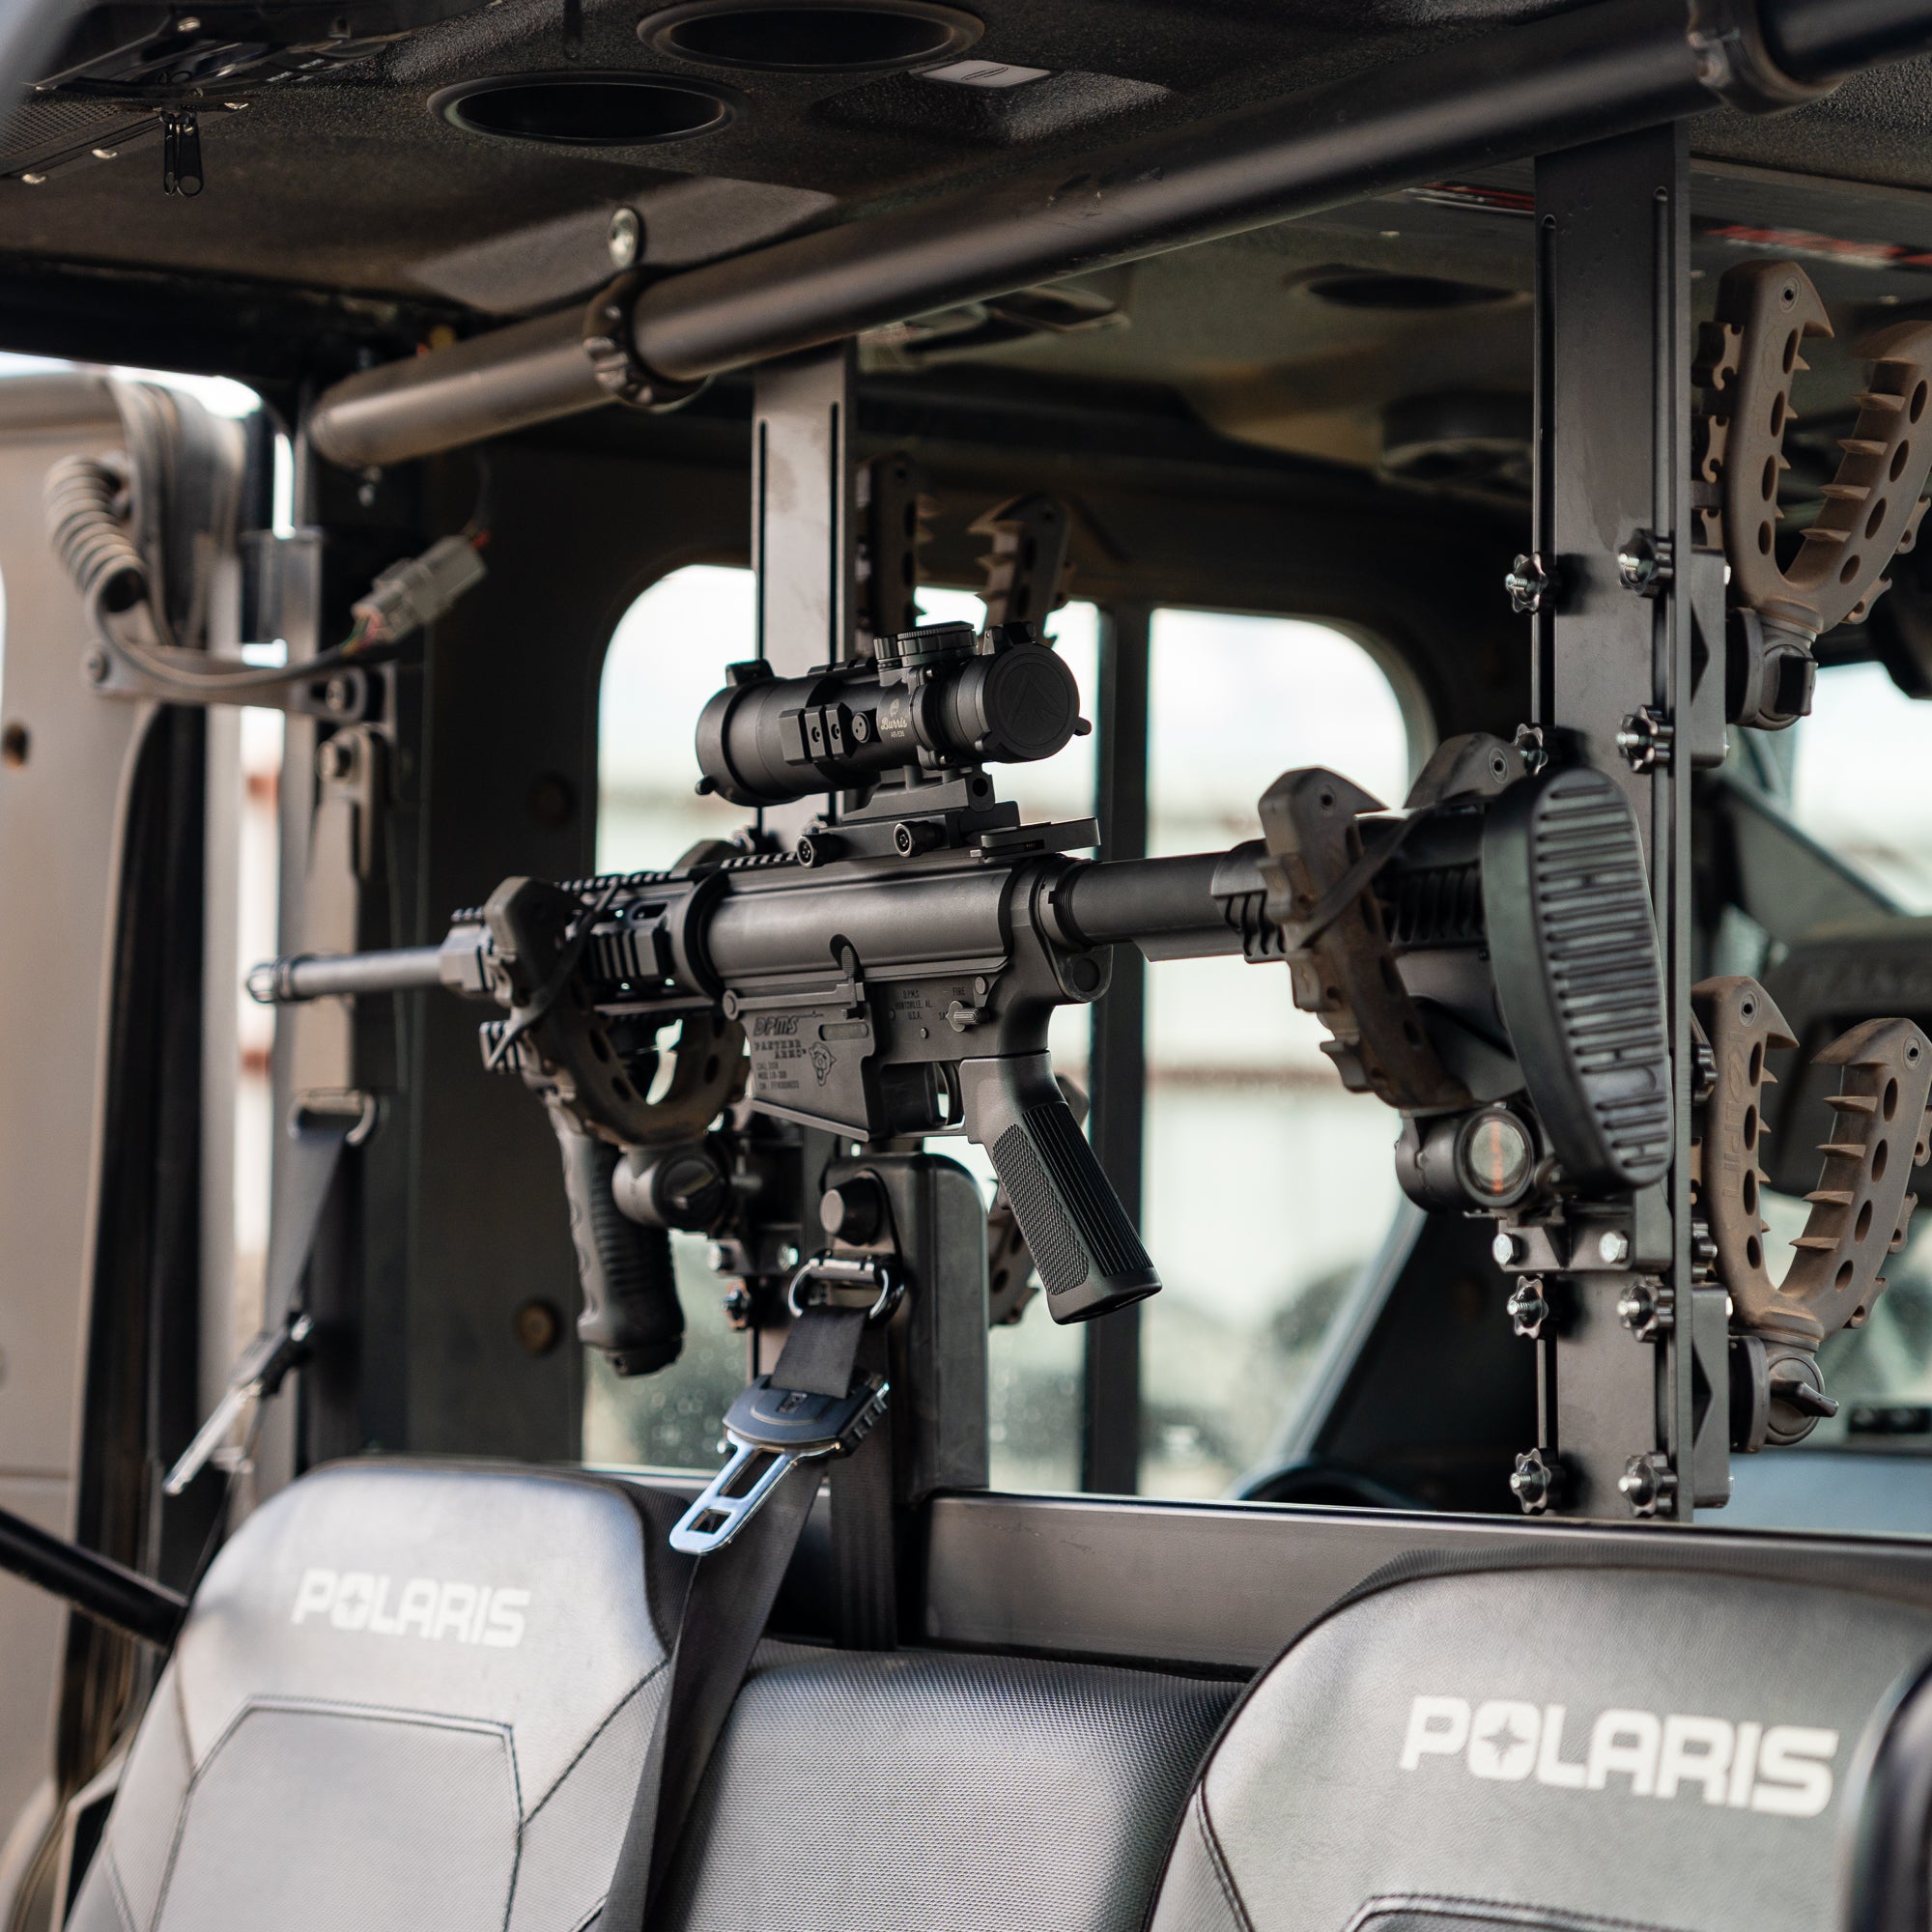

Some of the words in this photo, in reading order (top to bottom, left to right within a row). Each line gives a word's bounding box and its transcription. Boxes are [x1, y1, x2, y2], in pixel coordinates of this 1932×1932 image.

[952, 986, 966, 996] FIRE
[753, 1016, 799, 1037] DPMS
[291, 1569, 530, 1648] POLARIS
[1400, 1695, 1839, 1818] POLARIS
